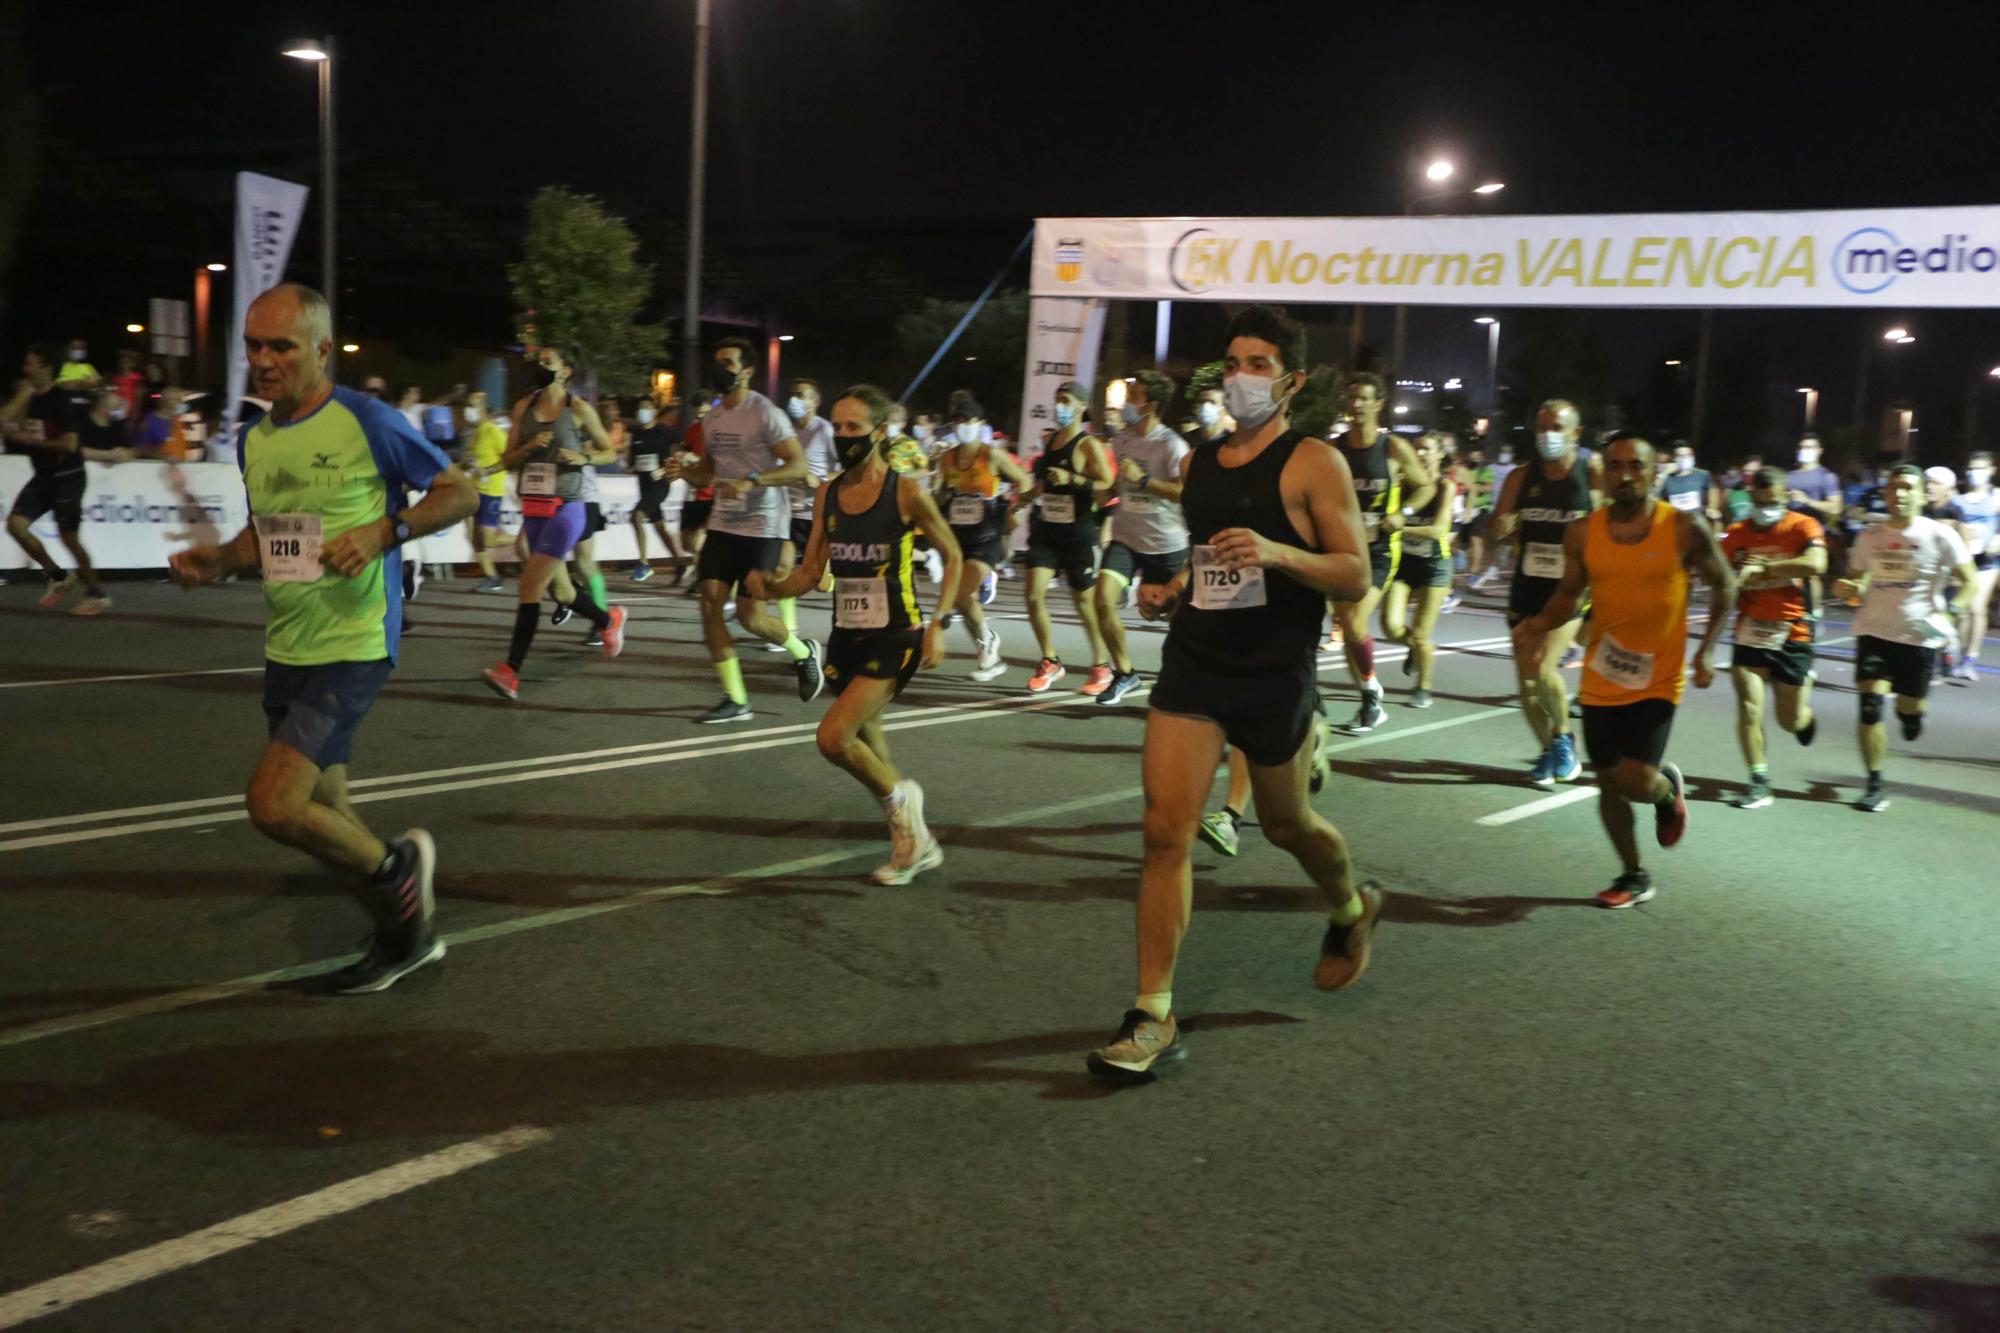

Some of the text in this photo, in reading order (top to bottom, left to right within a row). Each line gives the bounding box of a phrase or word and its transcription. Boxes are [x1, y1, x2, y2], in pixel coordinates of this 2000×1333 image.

[1246, 239, 1503, 286] Nocturna
[1516, 236, 1816, 288] VALENCIA
[1847, 234, 1996, 273] medio
[271, 538, 301, 557] 1218
[1203, 569, 1241, 587] 1720
